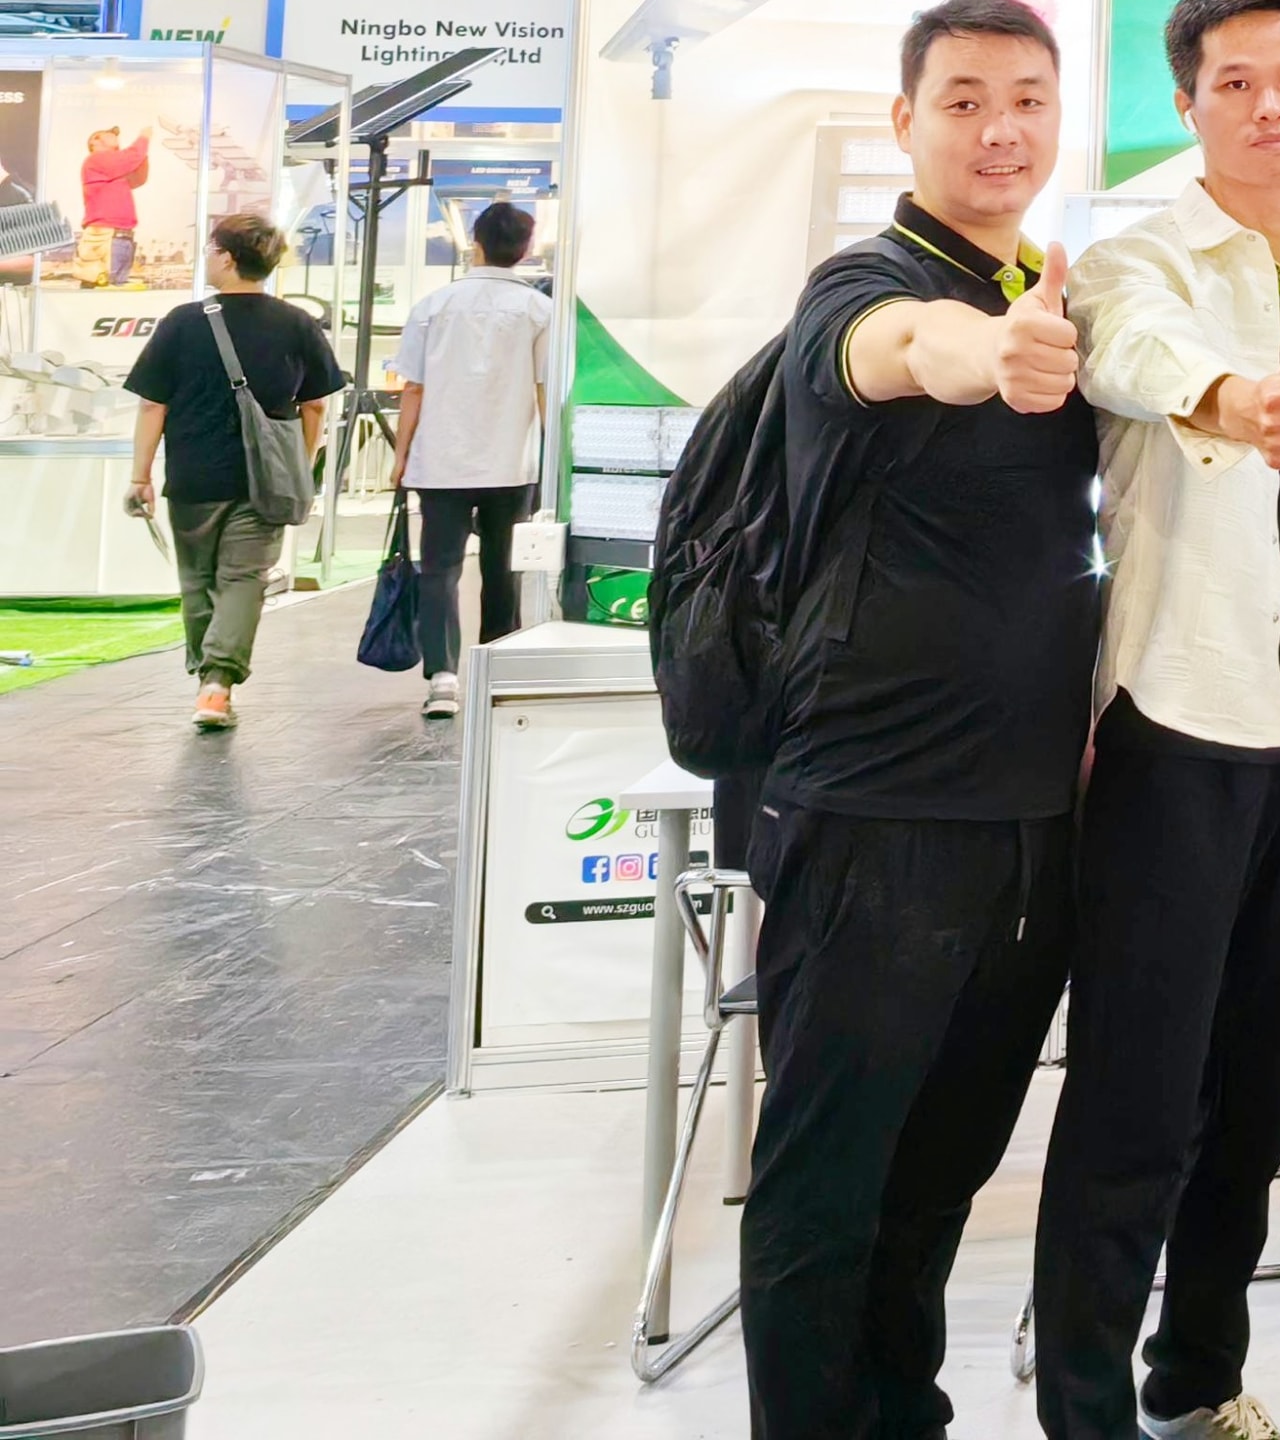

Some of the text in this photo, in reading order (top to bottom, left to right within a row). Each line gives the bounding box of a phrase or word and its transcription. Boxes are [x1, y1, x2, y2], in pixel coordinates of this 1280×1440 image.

[341, 19, 564, 39] Ningbo New Vision
[361, 45, 453, 66] Lightin
